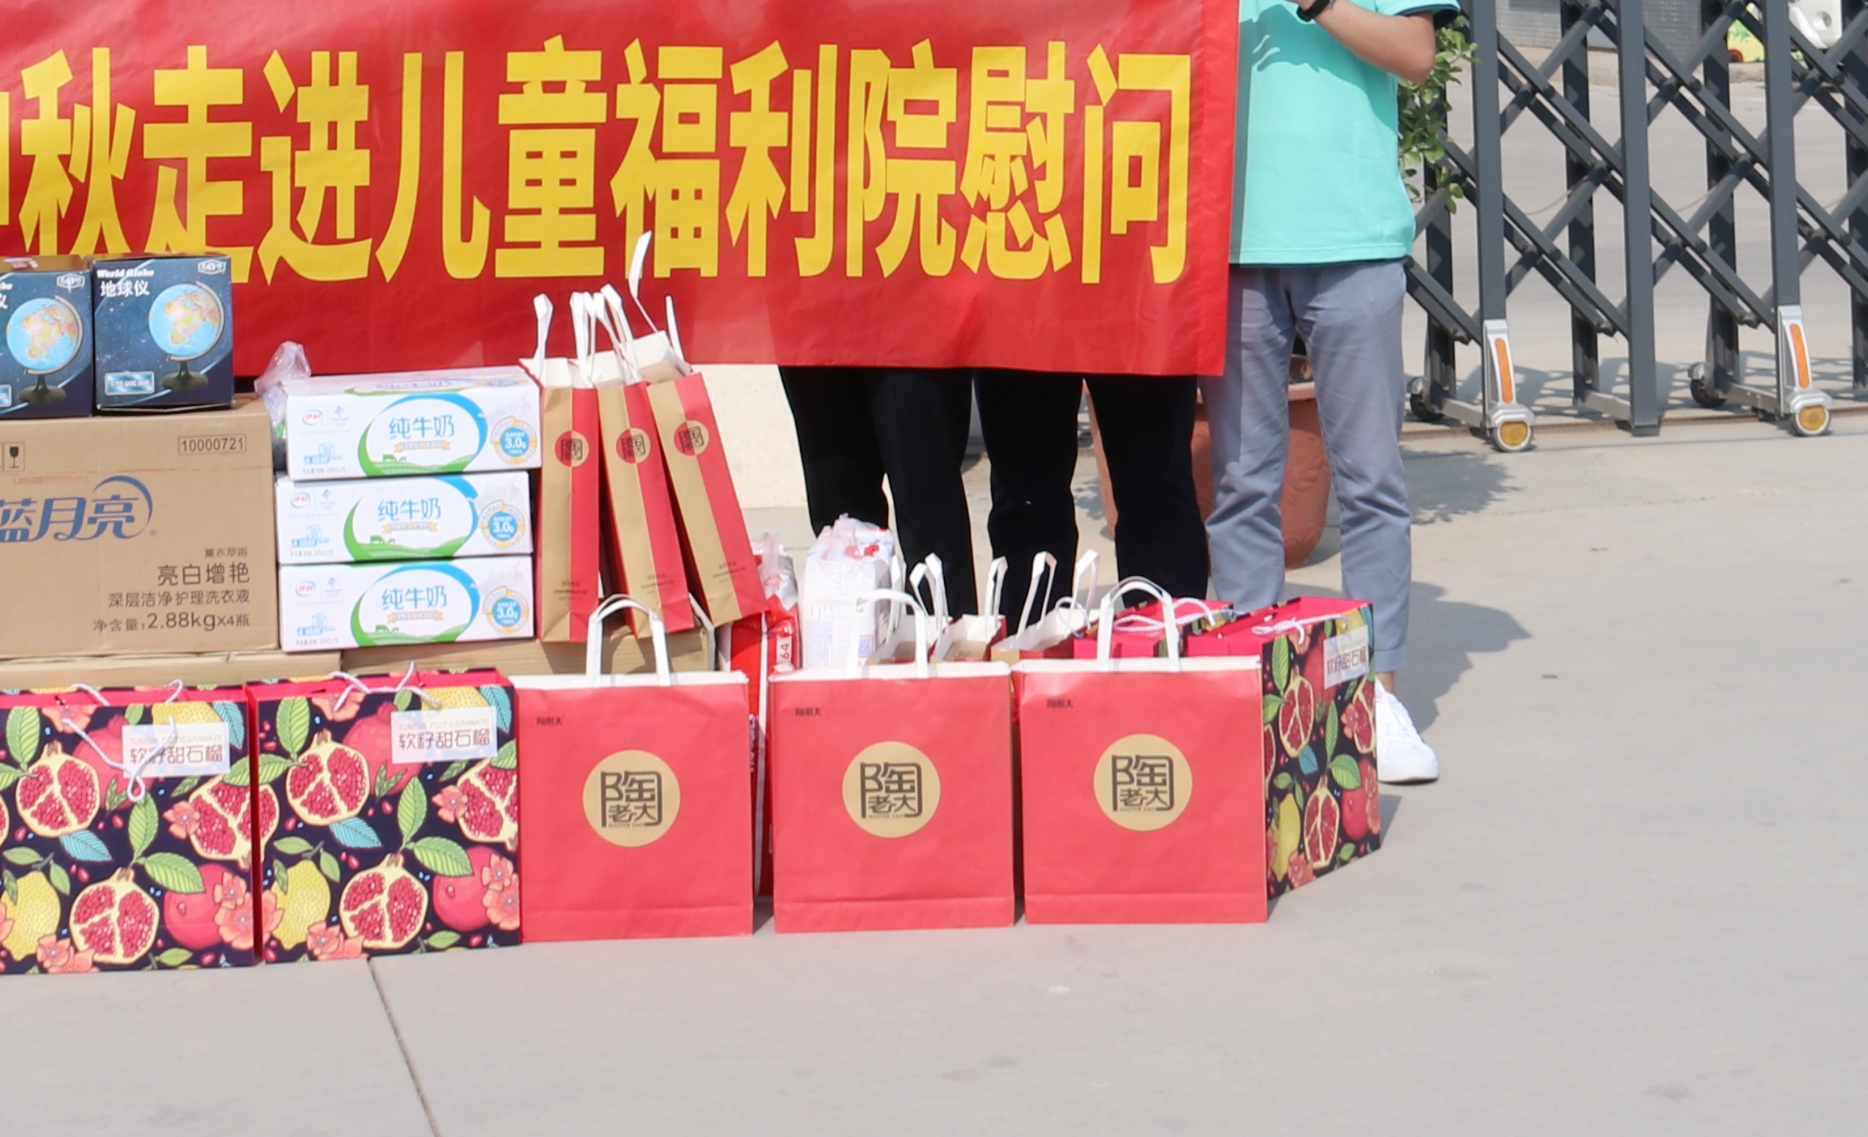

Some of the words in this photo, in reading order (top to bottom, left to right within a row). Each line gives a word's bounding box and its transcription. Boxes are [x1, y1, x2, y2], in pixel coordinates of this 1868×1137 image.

[96, 269, 125, 279] World
[126, 268, 154, 278] Globe
[100, 280, 150, 297] 地球仪
[389, 415, 455, 440] 纯牛奶
[181, 438, 245, 452] 10000721
[378, 497, 442, 522] 纯牛奶
[157, 562, 250, 587] 亮白增艳
[108, 589, 250, 609] 深层洁净护理洗衣液
[381, 585, 448, 611] 纯牛奶
[399, 728, 491, 751] 软籽甜石榴
